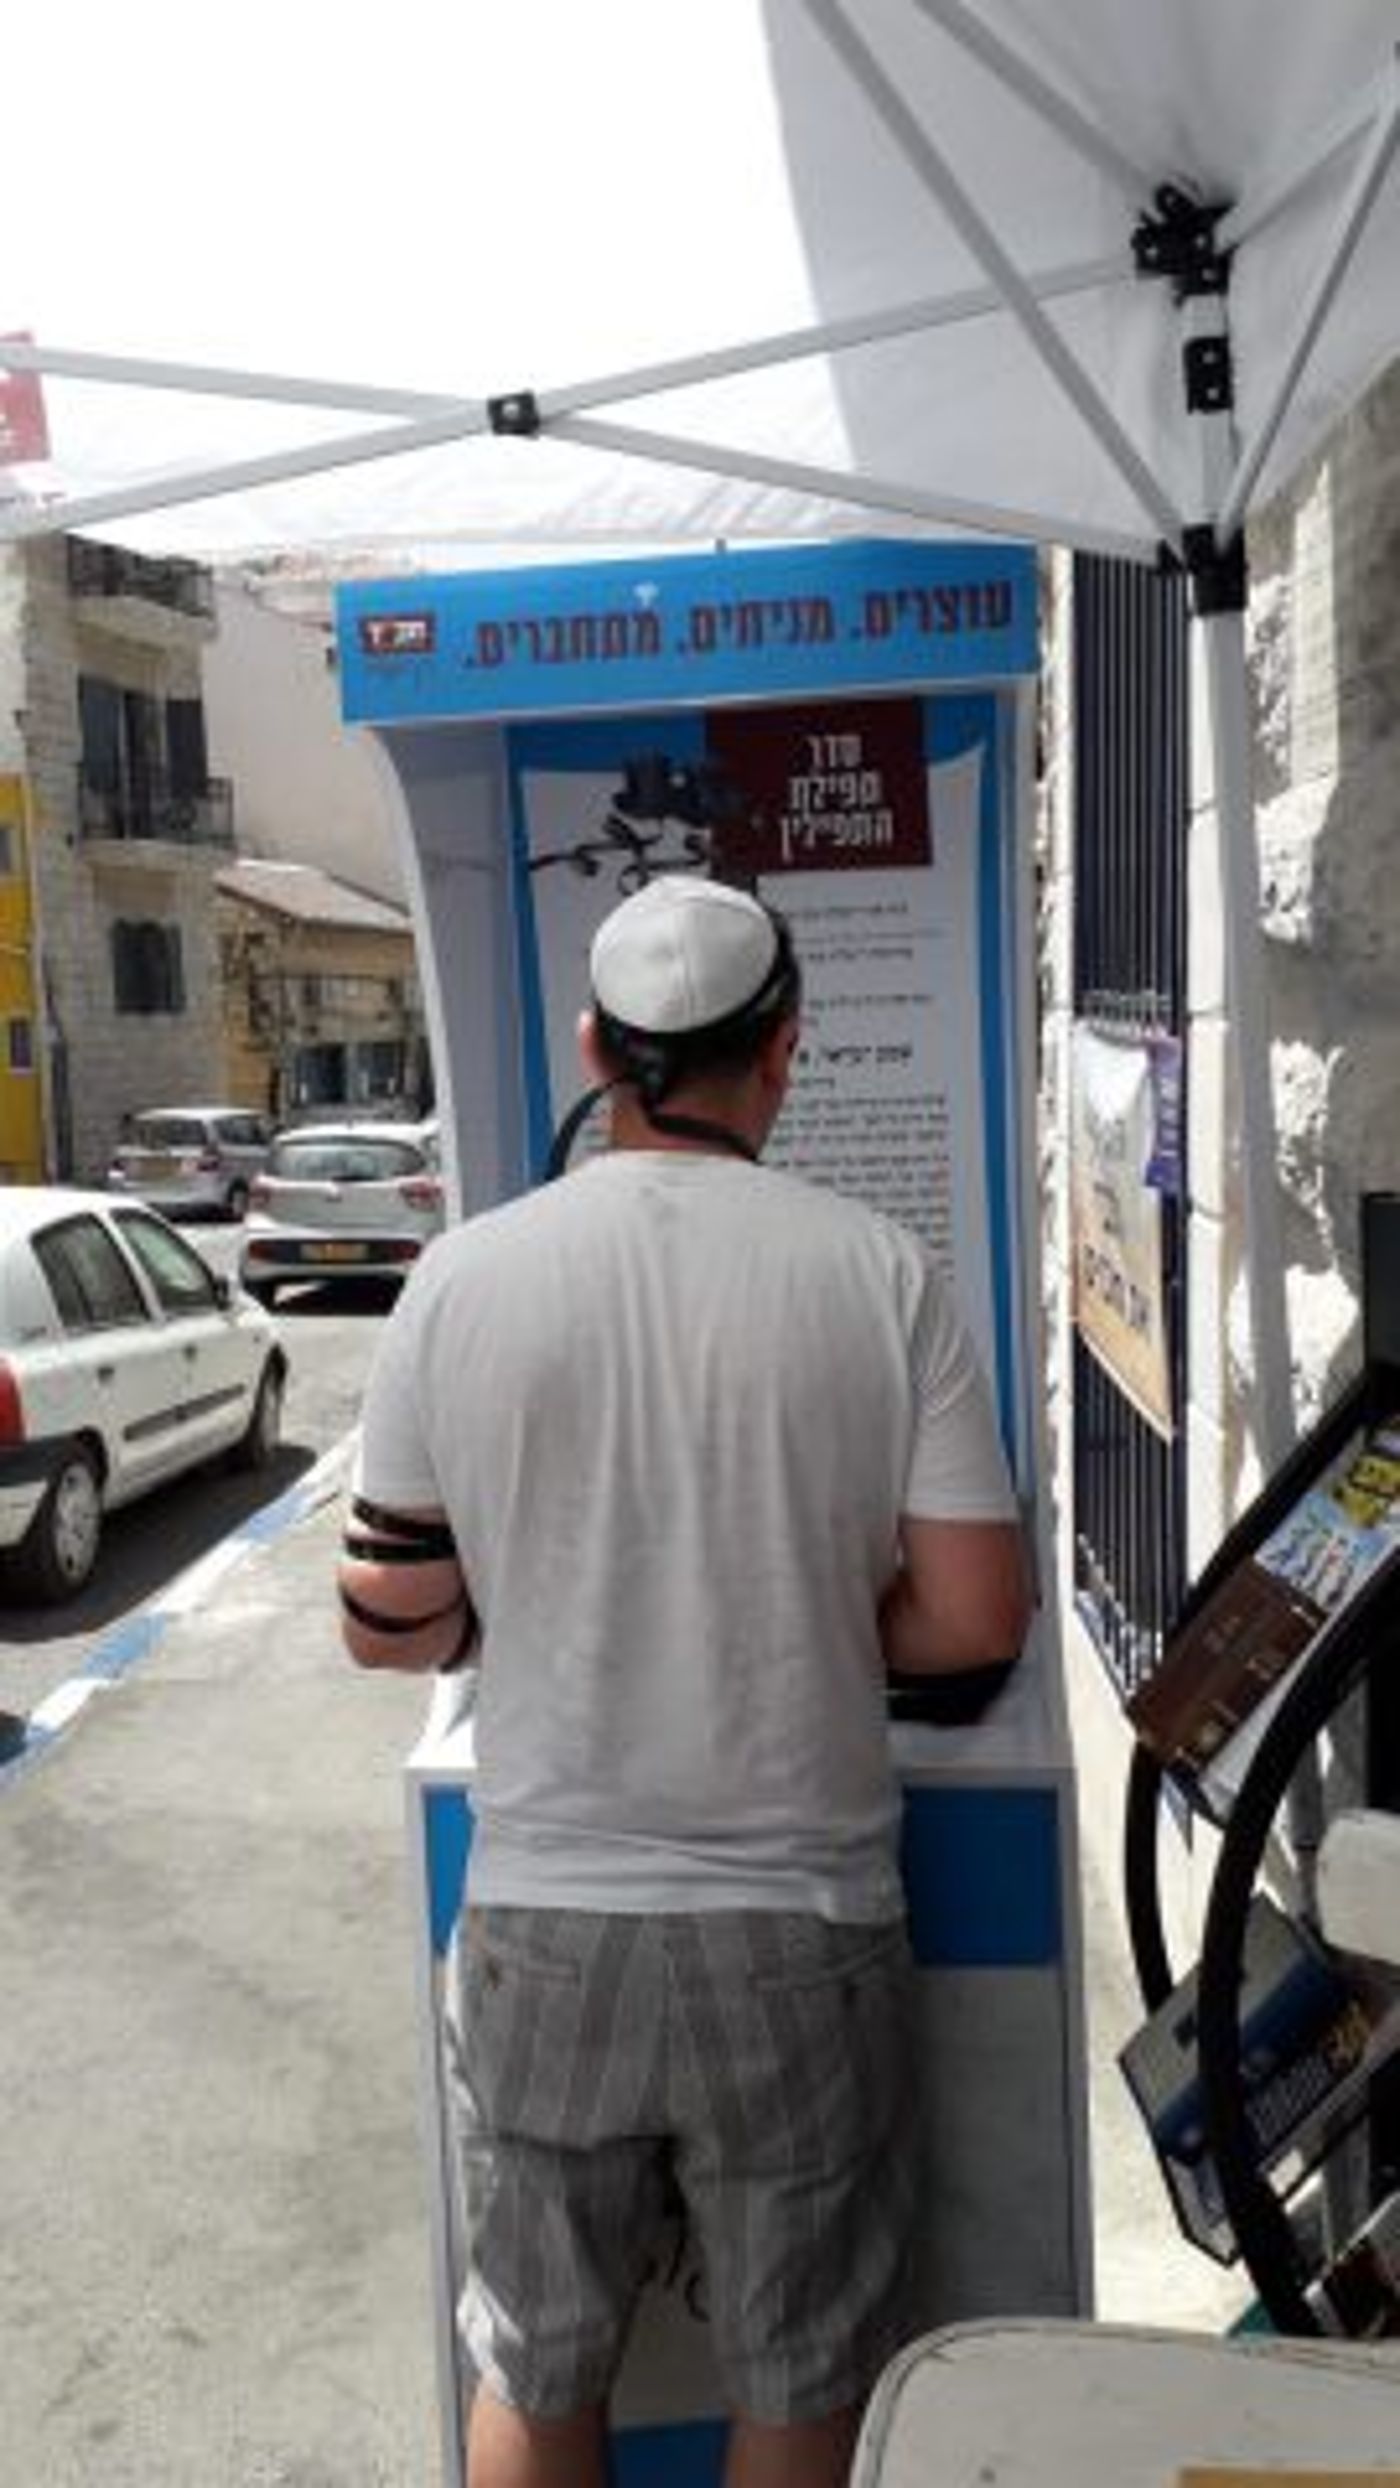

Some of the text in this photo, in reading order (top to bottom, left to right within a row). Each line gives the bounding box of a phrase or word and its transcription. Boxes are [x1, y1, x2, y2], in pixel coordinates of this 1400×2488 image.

[462, 579, 1013, 669] עוצרים. מניחים. מתחברים.
[806, 734, 862, 768] סדר
[788, 769, 882, 810] תפילת
[780, 806, 894, 864] התפילין
